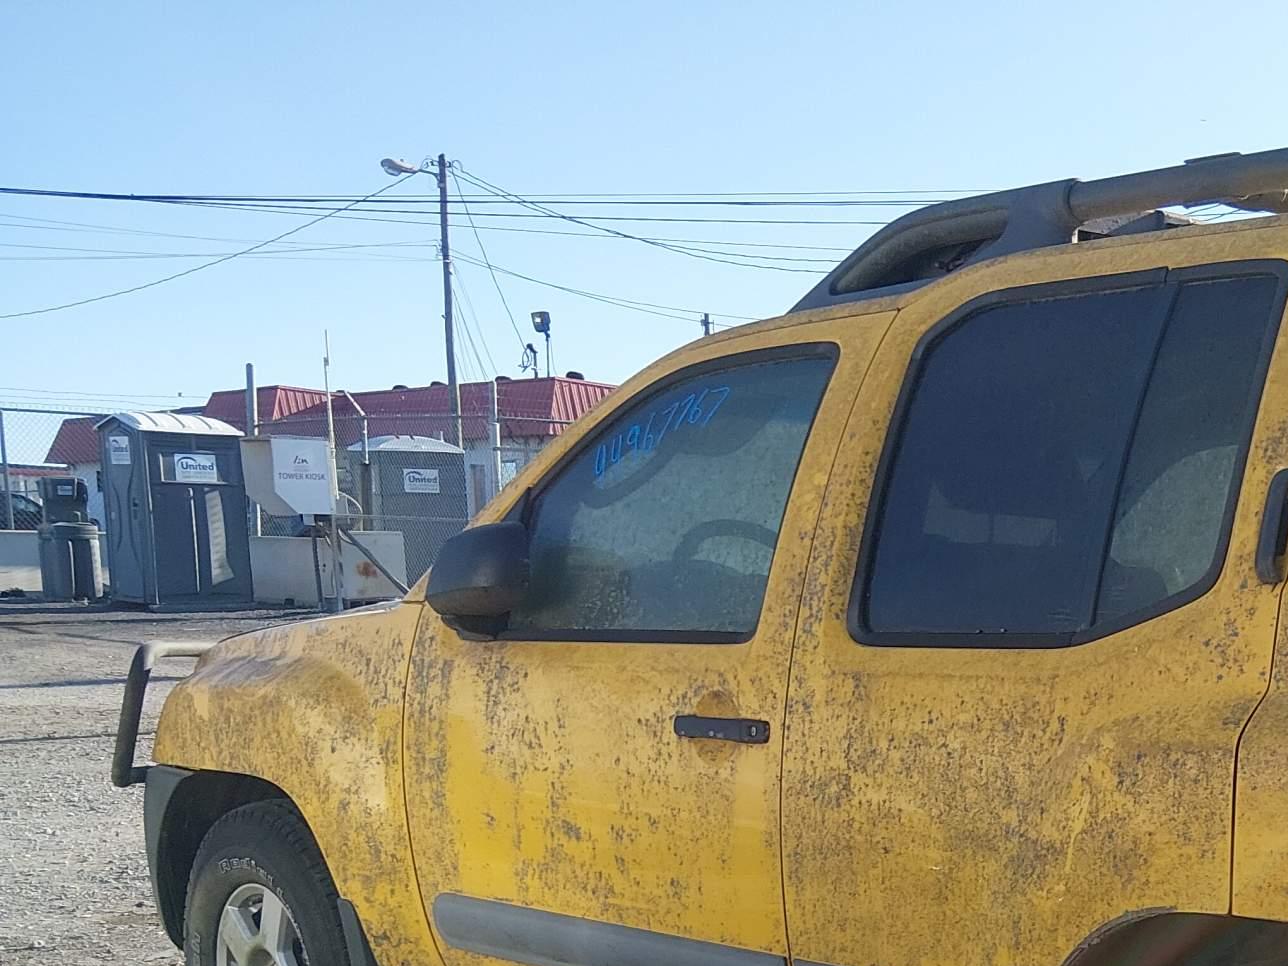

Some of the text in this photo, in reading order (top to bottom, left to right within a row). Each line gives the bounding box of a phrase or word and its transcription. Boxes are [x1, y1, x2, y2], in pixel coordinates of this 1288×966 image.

[180, 460, 215, 471] United
[278, 472, 303, 480] TOWER
[408, 475, 438, 484] United
